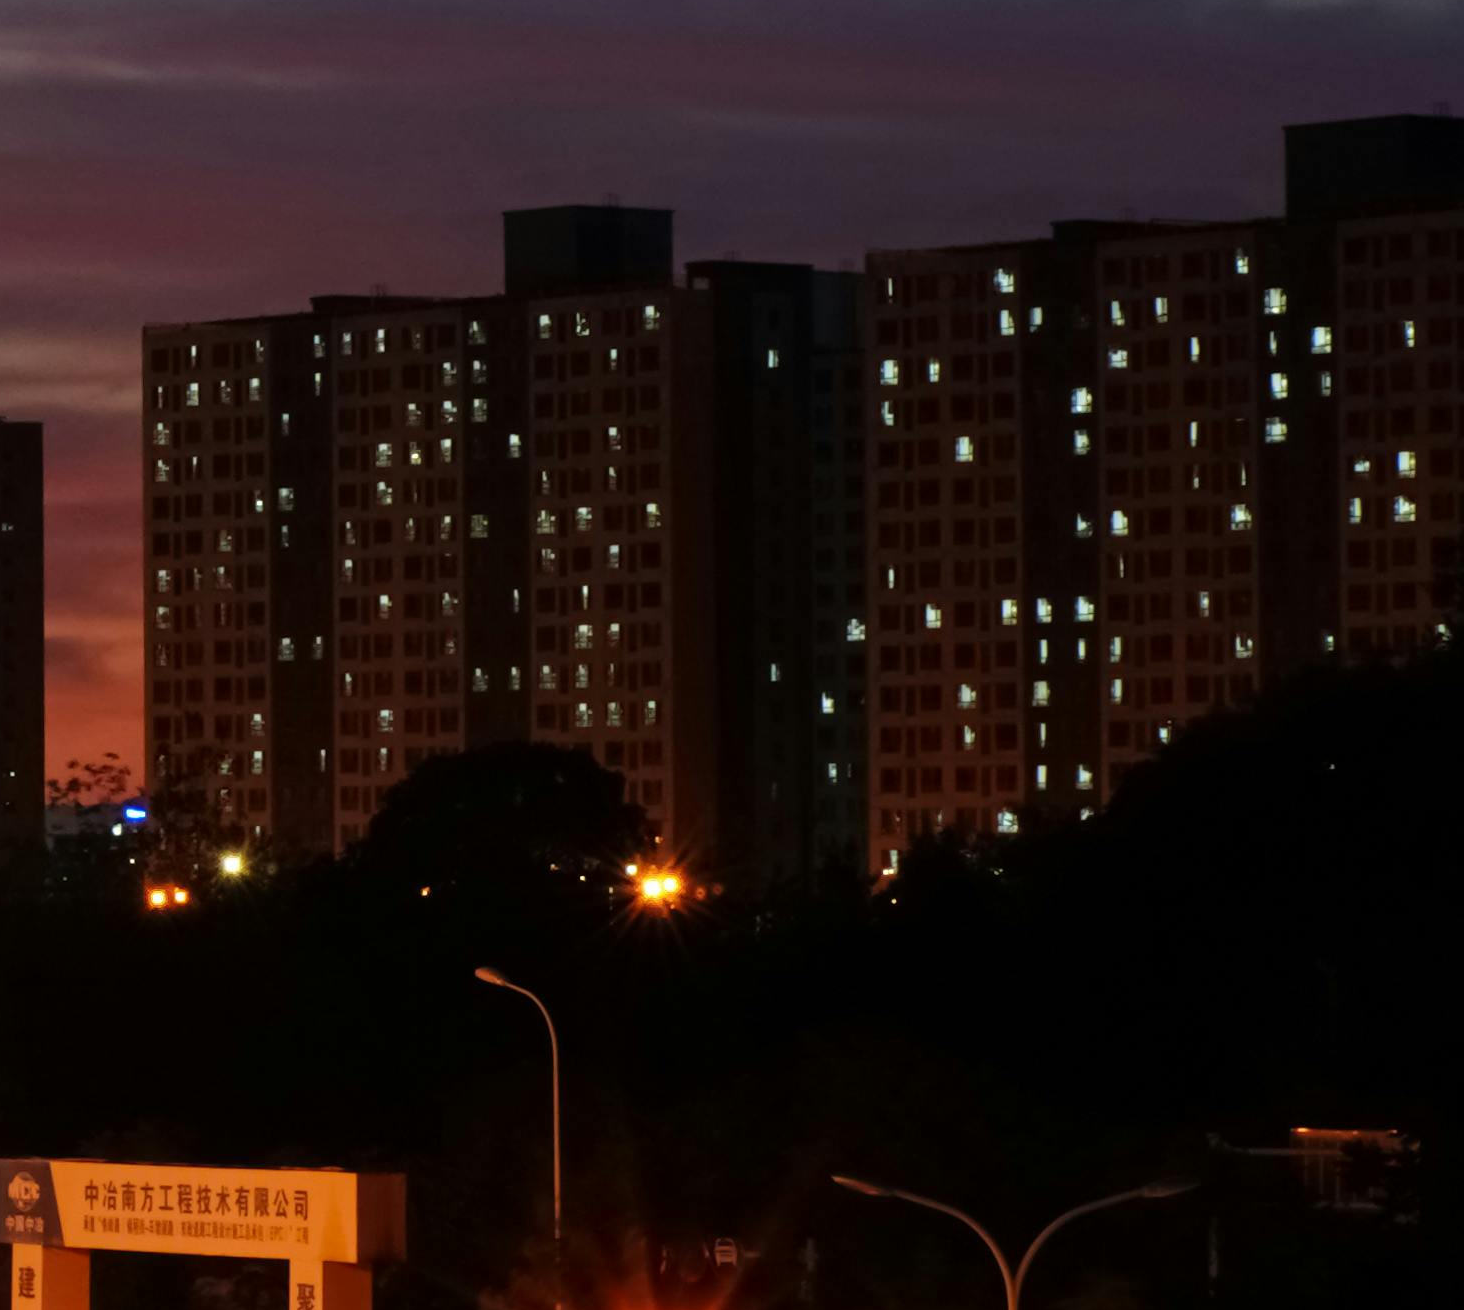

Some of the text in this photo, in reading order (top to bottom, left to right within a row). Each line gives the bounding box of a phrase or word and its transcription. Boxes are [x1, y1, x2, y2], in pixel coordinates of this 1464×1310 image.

[84, 1179, 309, 1221] 中冶南方工程技术有限公司
